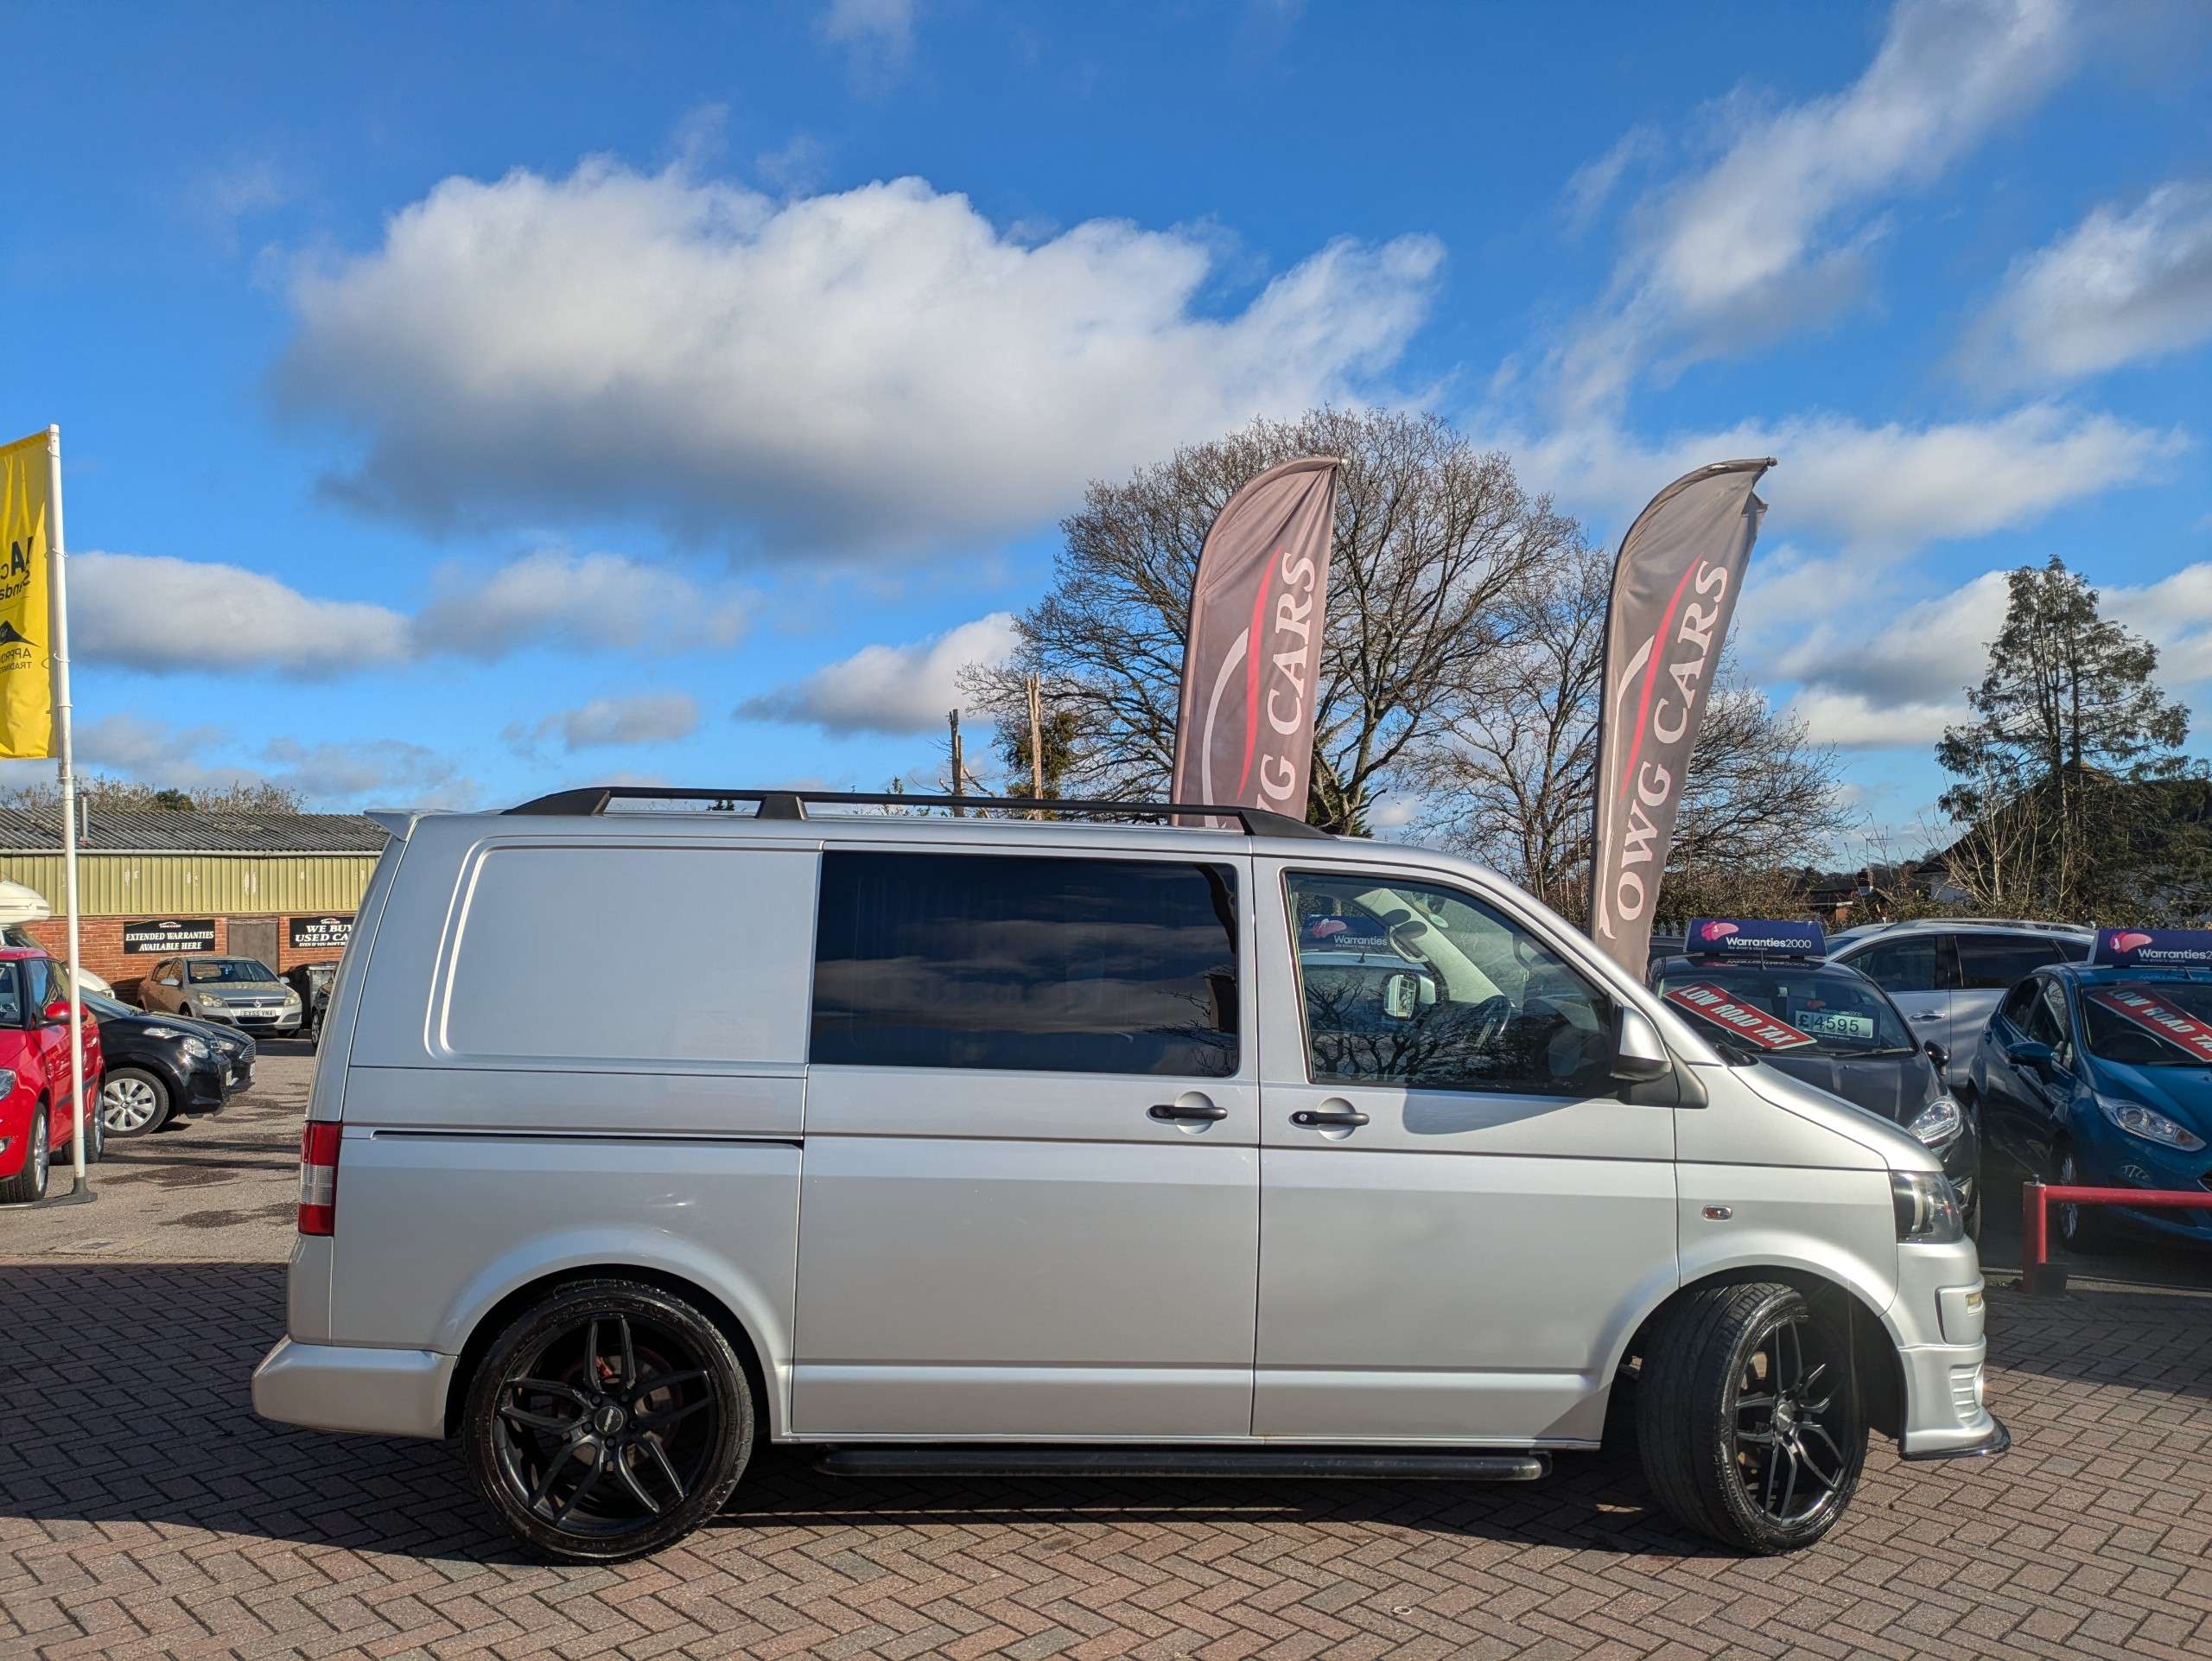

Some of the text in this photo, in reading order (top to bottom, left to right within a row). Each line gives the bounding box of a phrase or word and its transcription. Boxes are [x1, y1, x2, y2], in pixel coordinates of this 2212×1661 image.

[1255, 551, 1316, 811] G CARS
[1616, 559, 1730, 922] OWG CARS
[329, 924, 353, 932] BUY
[125, 931, 214, 941] EXTENDED WARRANTIES
[295, 933, 330, 942] USED
[1333, 934, 1388, 945] Warranties
[138, 941, 202, 951] AVAILABLE HERE
[1726, 936, 1812, 949] Warranties2000
[2137, 948, 2212, 960] Warranties2
[1678, 986, 1798, 1044] LOW ROAD TAX
[2142, 1007, 2196, 1033] ROAD
[2190, 1034, 2212, 1052] TA
